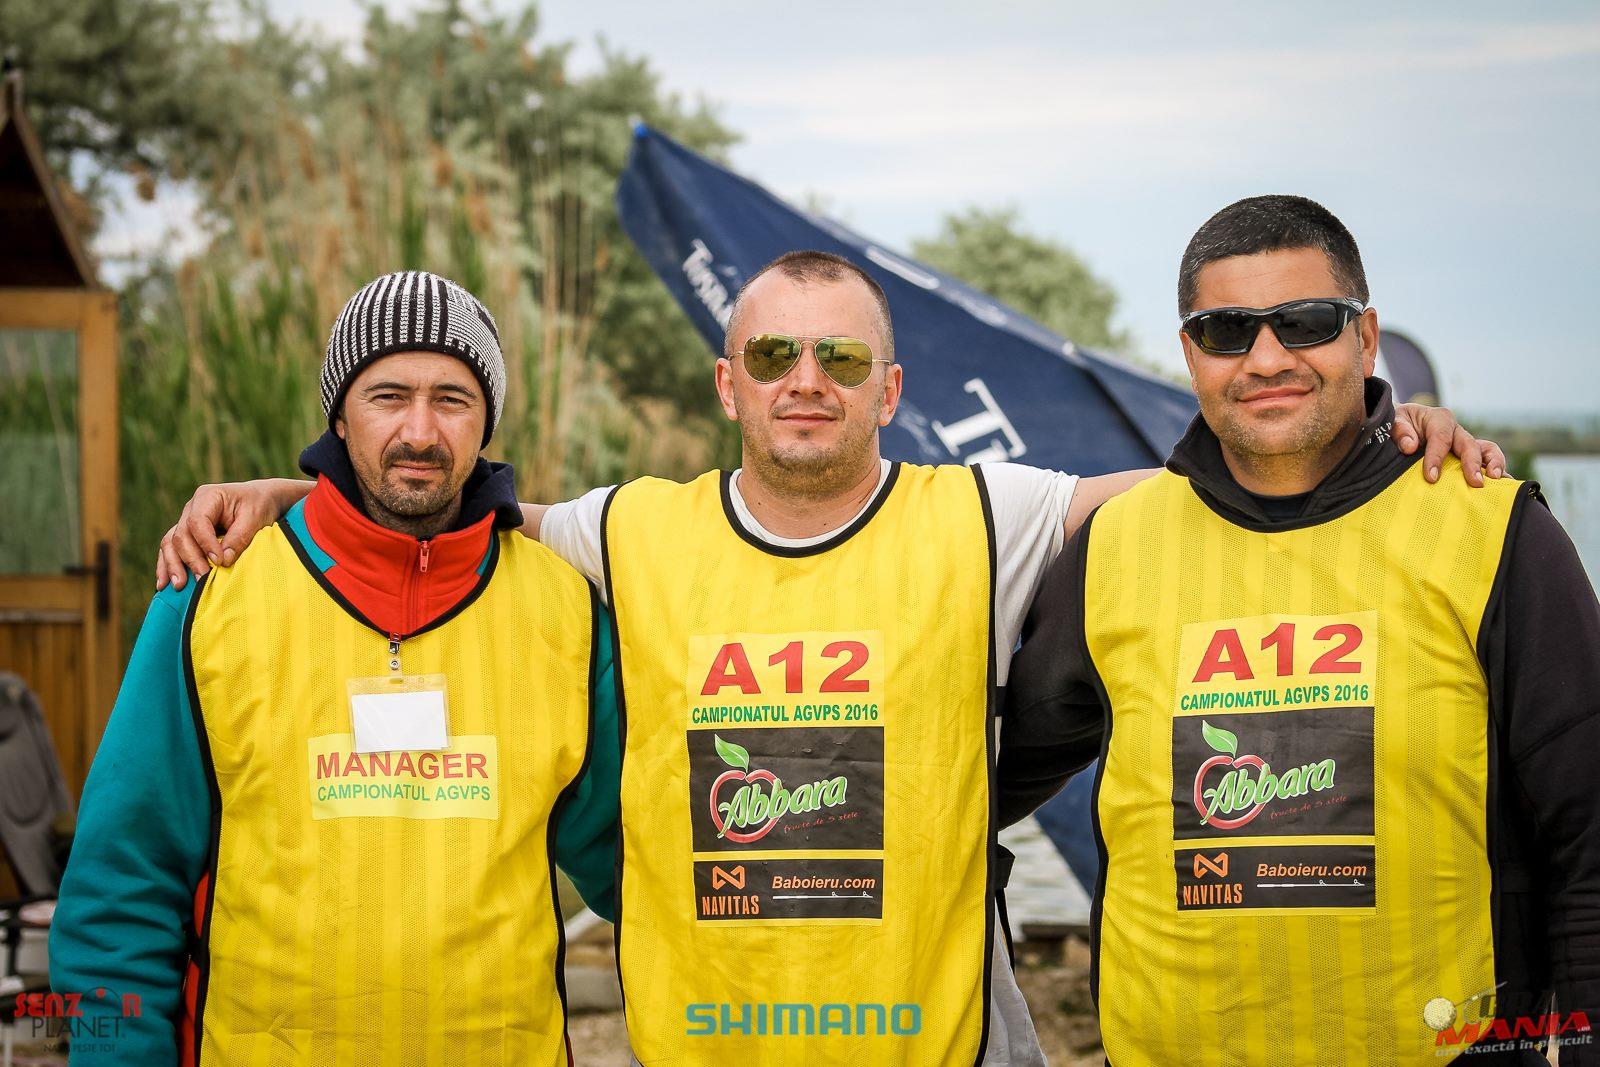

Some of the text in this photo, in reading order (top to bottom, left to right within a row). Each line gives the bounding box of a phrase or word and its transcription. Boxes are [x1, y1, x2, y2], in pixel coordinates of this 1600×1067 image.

[1191, 622, 1363, 684] A12
[700, 640, 870, 696] A12
[1180, 684, 1369, 711] CAMPIONATUL AGVPS 2016
[692, 703, 878, 724] CAMPIONATUL AGVPS 2016
[316, 751, 489, 780] MANAGER
[317, 783, 491, 801] CAMPIONATUL AGVPS
[1200, 758, 1336, 826] Abbara
[716, 776, 848, 839] Abbara
[772, 876, 876, 889] Baboieru.com
[1256, 863, 1368, 877] Baboieru.com
[702, 895, 760, 916] NAVITAS
[1183, 883, 1243, 906] NAVITAS
